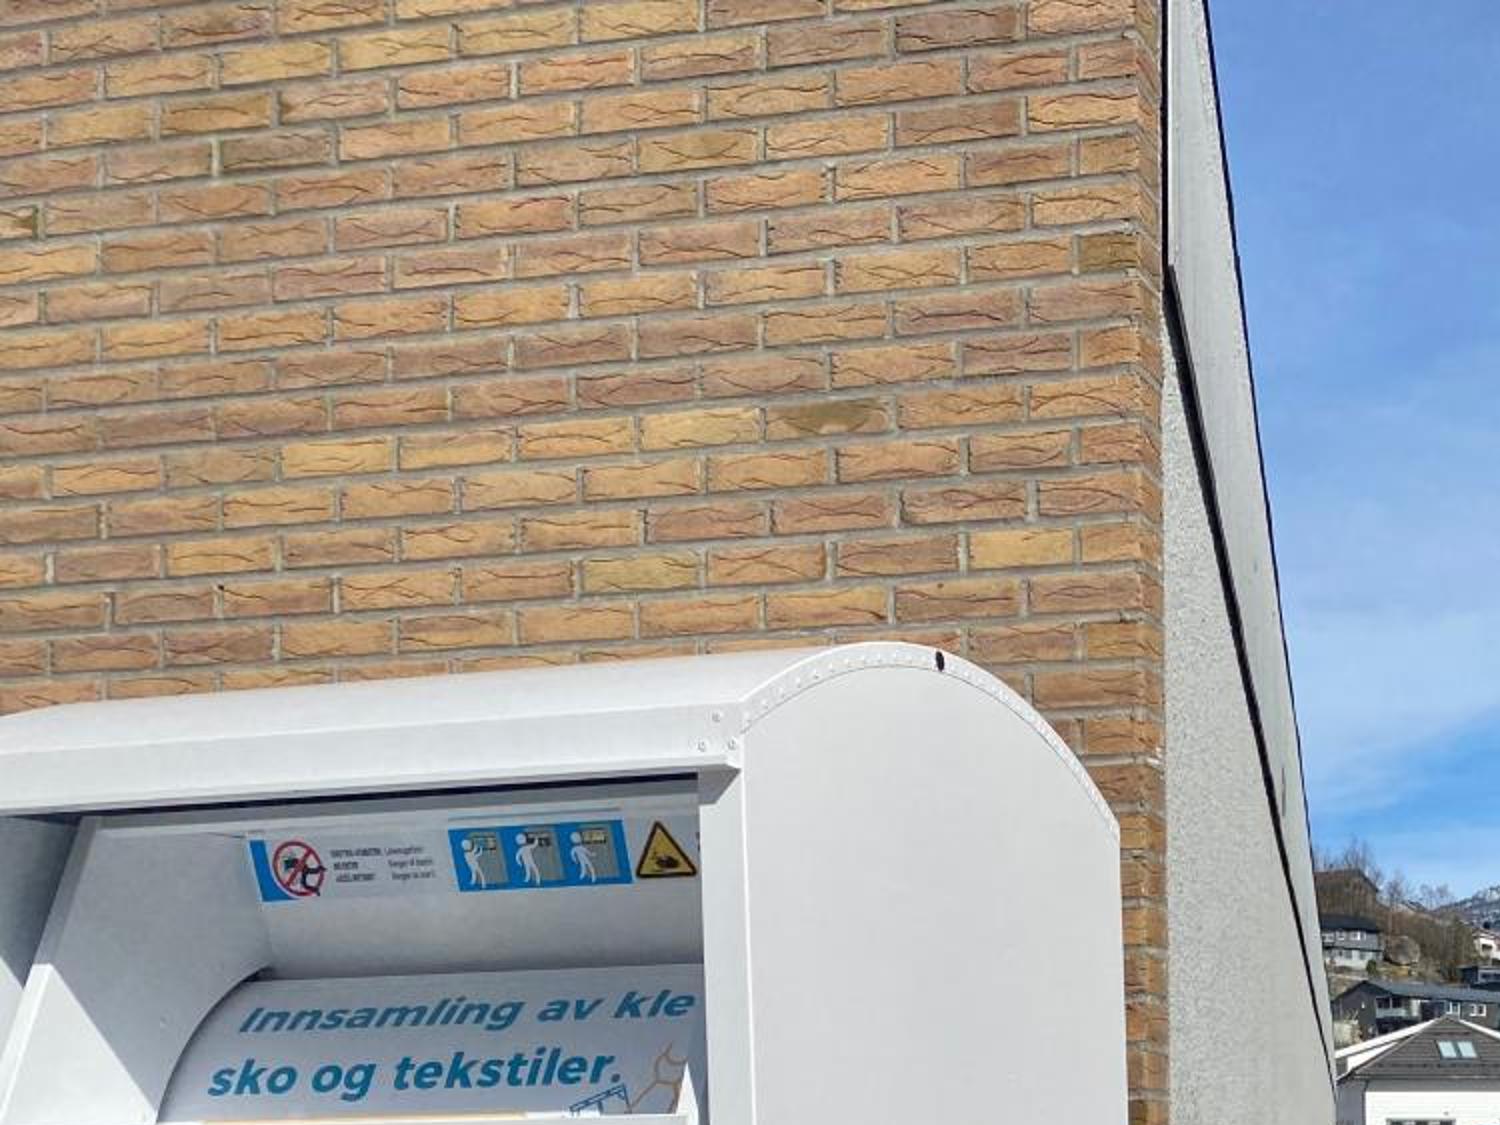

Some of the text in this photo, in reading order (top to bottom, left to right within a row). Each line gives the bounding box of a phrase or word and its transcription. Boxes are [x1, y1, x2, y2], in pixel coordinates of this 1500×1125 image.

[239, 989, 696, 1033] Innsamling av kle
[208, 1047, 621, 1102] sko og tekstiler.
